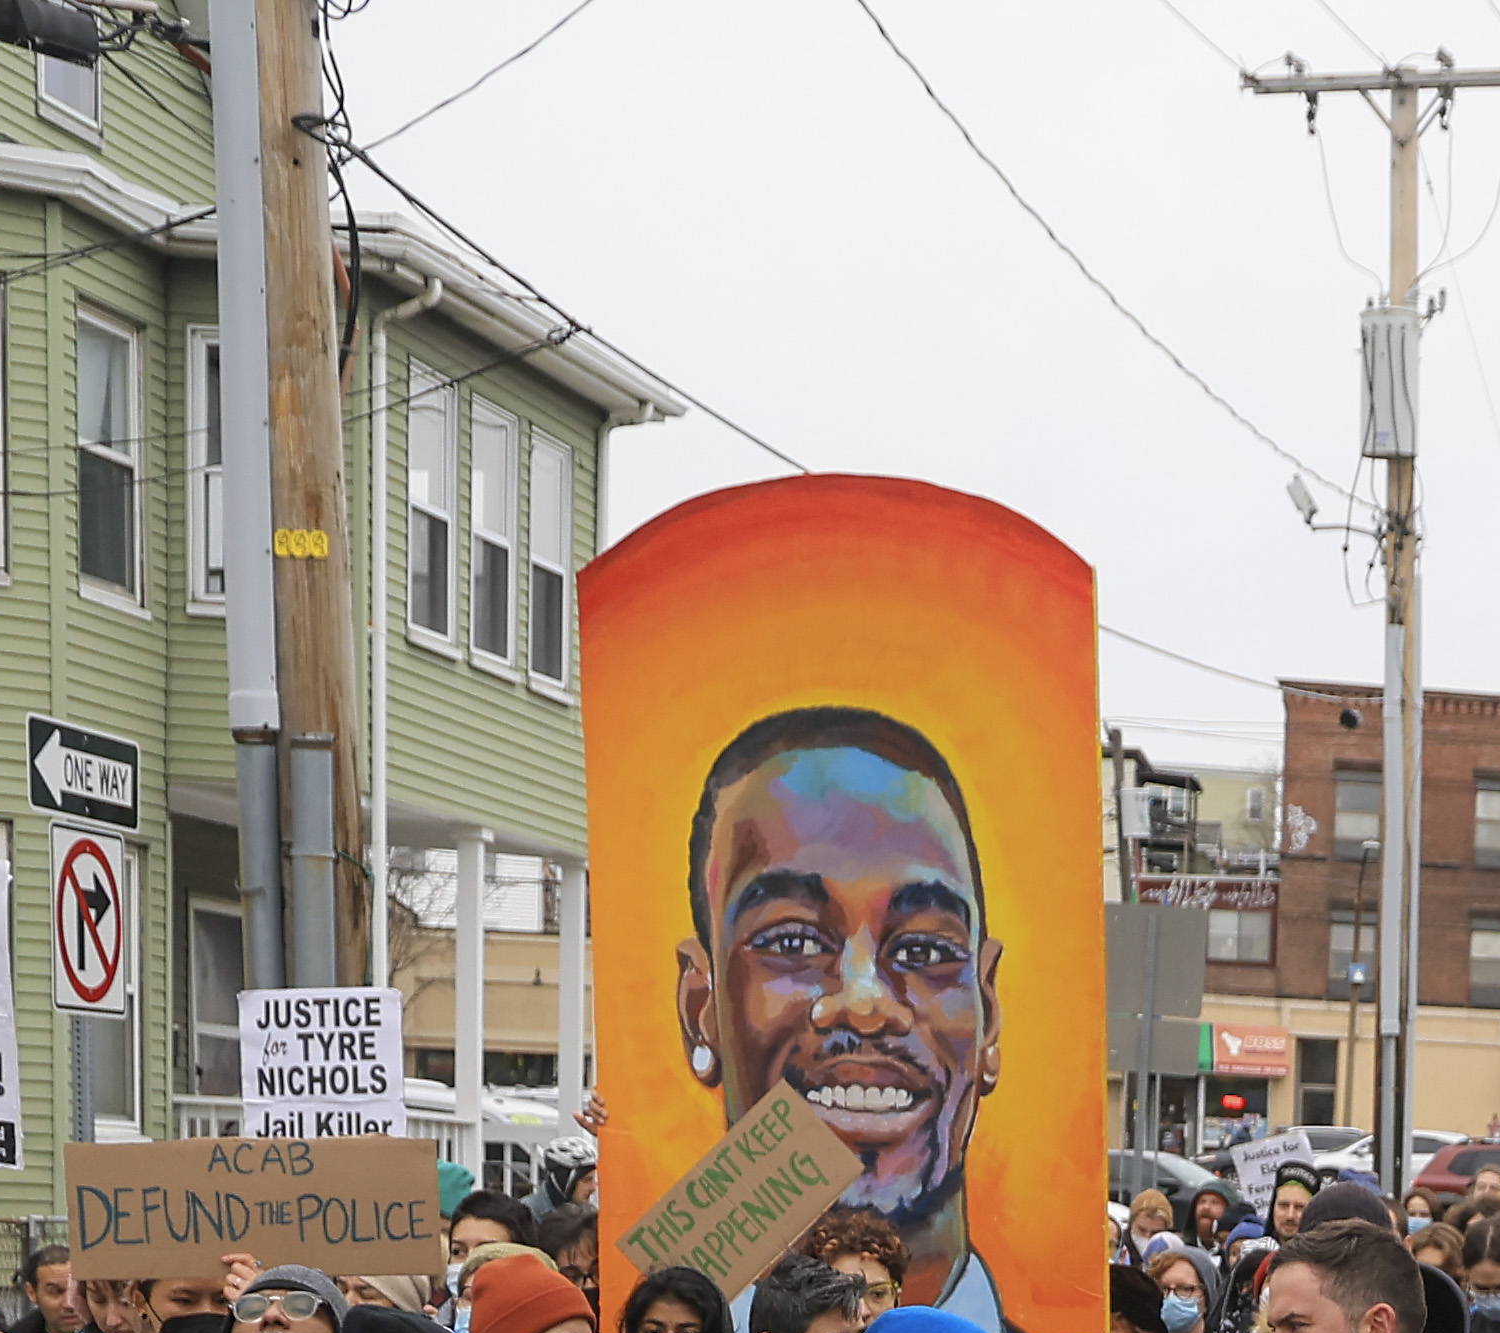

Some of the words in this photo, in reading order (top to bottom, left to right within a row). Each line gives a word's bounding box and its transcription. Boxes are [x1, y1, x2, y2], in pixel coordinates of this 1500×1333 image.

[64, 753, 93, 792] ONE
[98, 760, 128, 800] WAY
[256, 997, 382, 1029] JUSTICE
[262, 1032, 287, 1065] for
[297, 1031, 376, 1061] TYRE
[257, 1064, 387, 1096] NICHOLS
[256, 1111, 303, 1138] Jail
[316, 1111, 392, 1138] Killer
[208, 1142, 314, 1175] ACAB
[1243, 1146, 1280, 1161] Justice
[1282, 1141, 1299, 1152] for
[628, 1200, 695, 1261] THIS
[734, 1098, 793, 1164] KEEP
[75, 1185, 251, 1251] DEFUND
[254, 1201, 293, 1225] THE
[296, 1192, 433, 1244] POLICE
